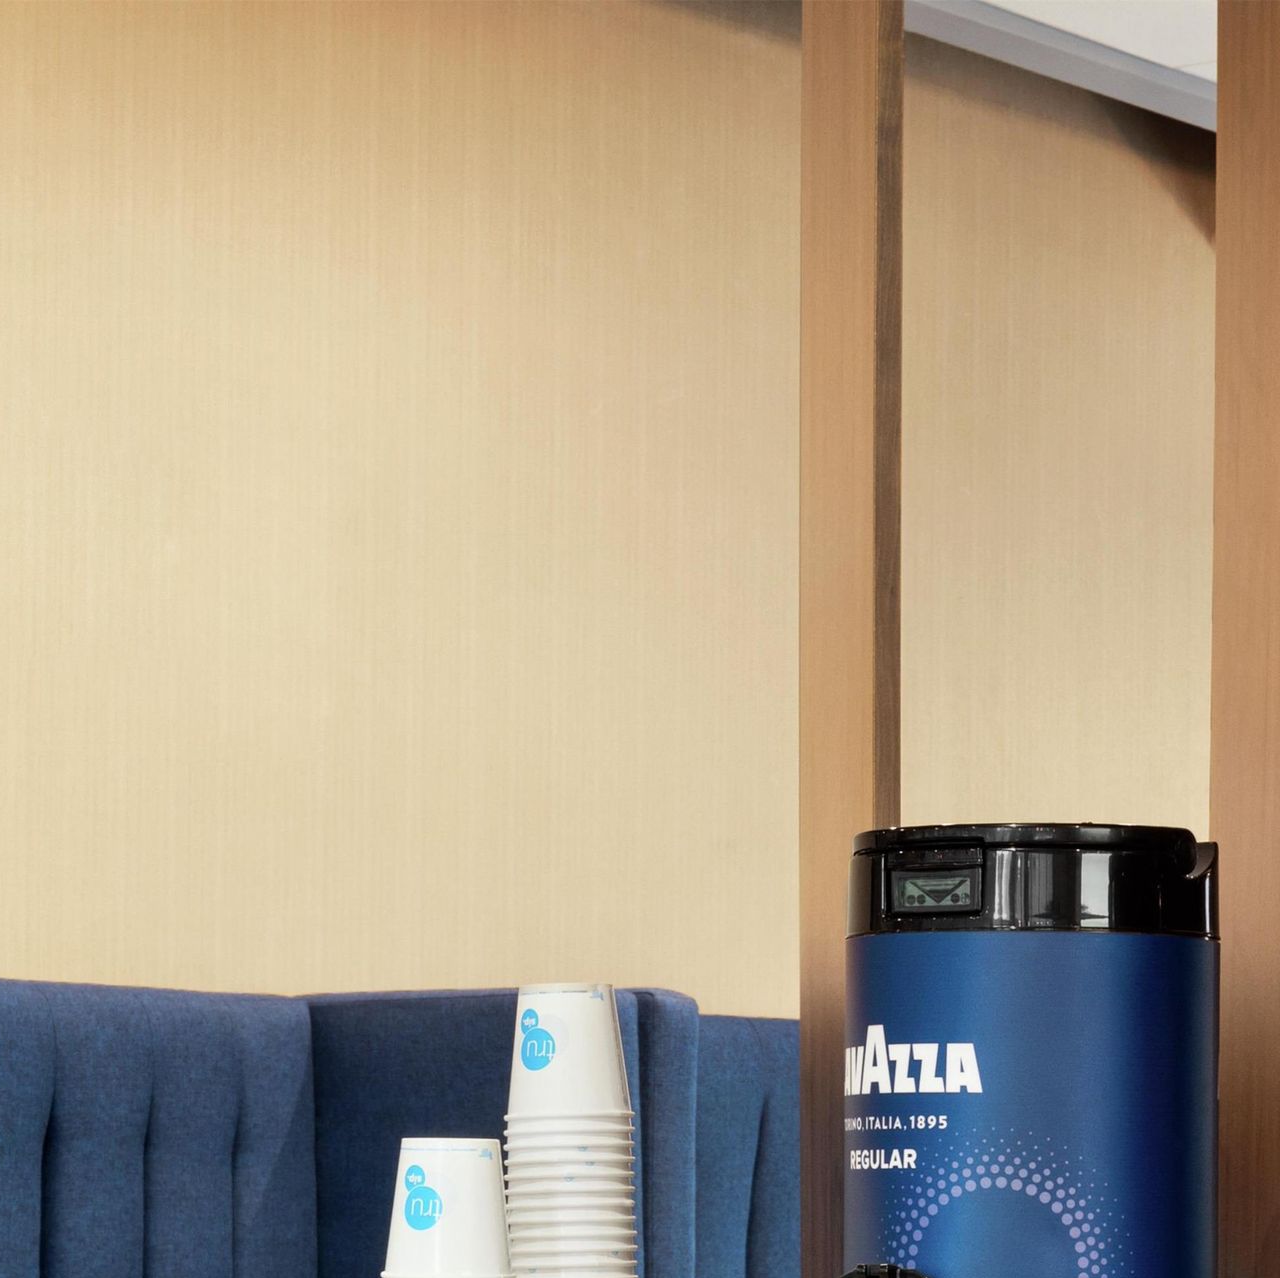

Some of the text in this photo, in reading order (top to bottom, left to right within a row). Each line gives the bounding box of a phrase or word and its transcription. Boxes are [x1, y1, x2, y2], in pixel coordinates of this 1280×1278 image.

[526, 1040, 555, 1061] tru
[844, 1024, 983, 1096] AVAZZA
[909, 1115, 948, 1129] 1895
[850, 1149, 917, 1170] REGULAR
[410, 1198, 443, 1221] tru
